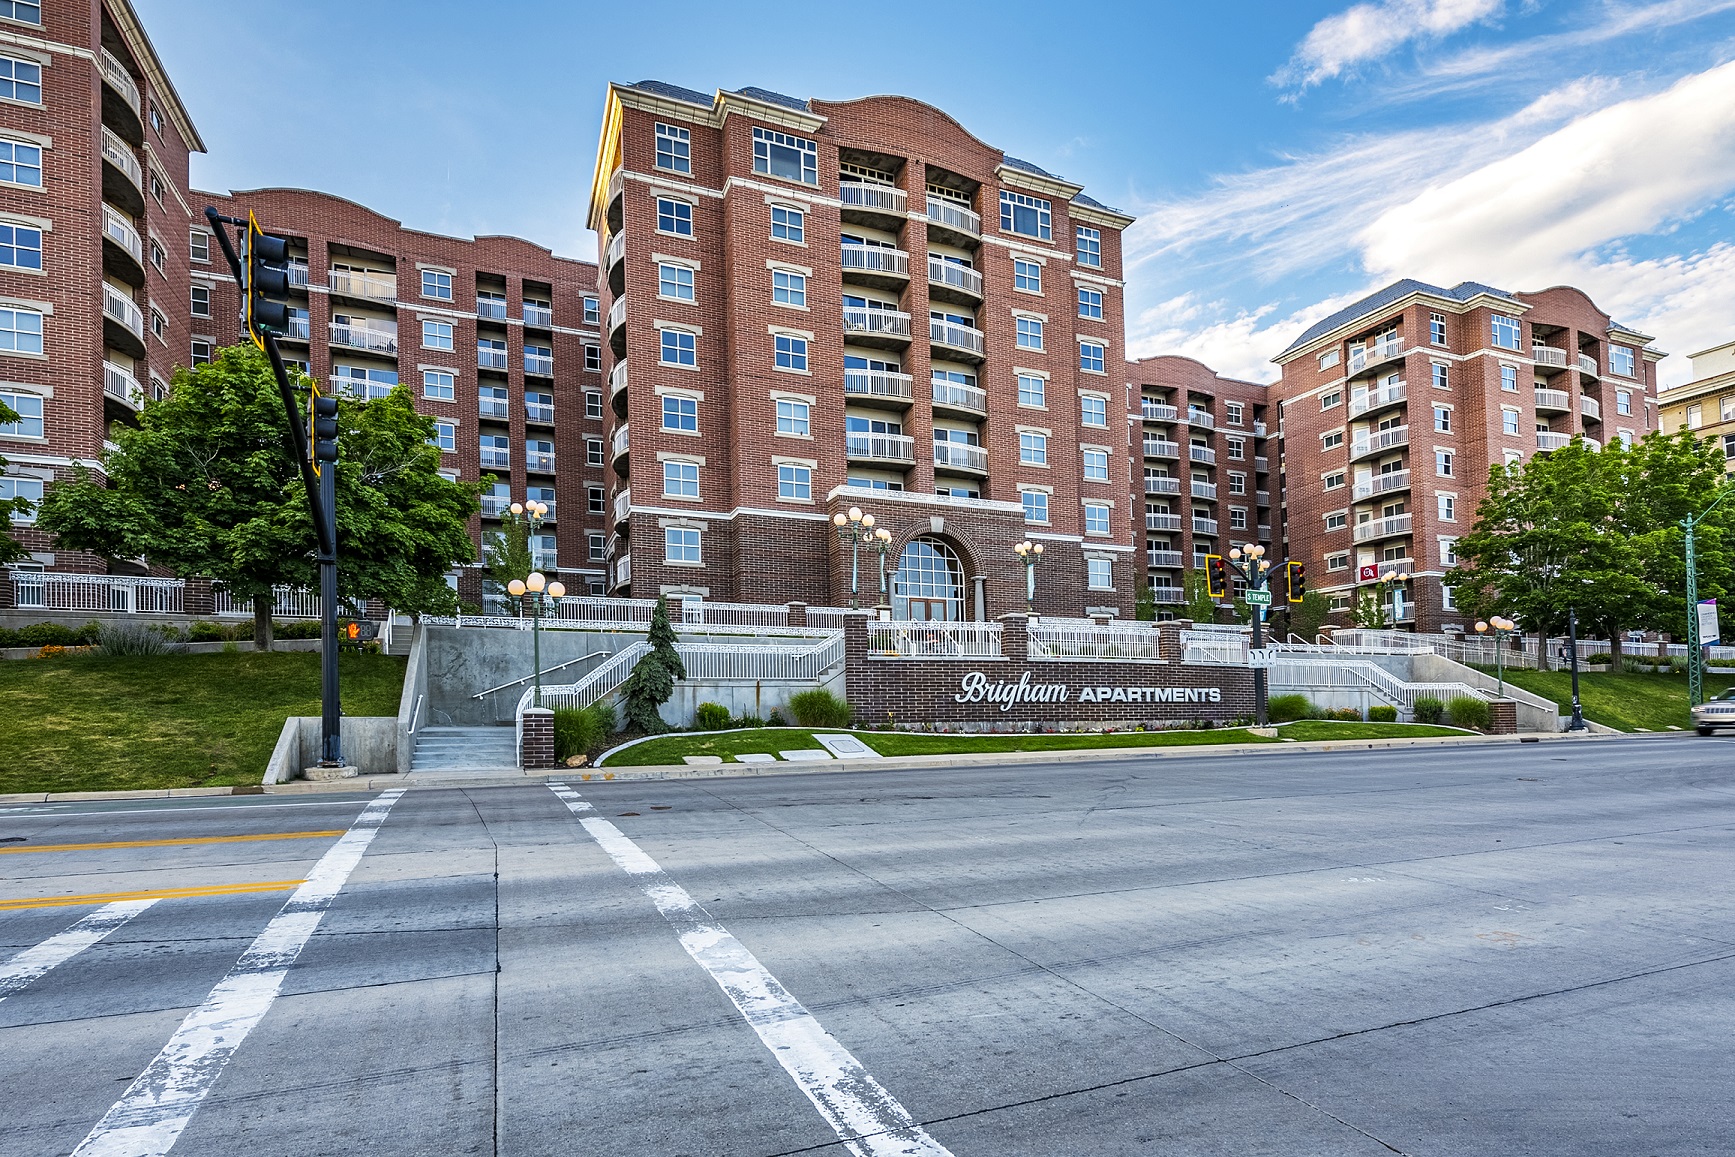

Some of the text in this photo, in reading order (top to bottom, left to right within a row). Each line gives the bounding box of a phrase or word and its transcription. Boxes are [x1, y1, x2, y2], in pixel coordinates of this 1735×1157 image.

[1252, 593, 1270, 602] TEMPLE
[955, 671, 1221, 711] Brigham APARTMENTS
